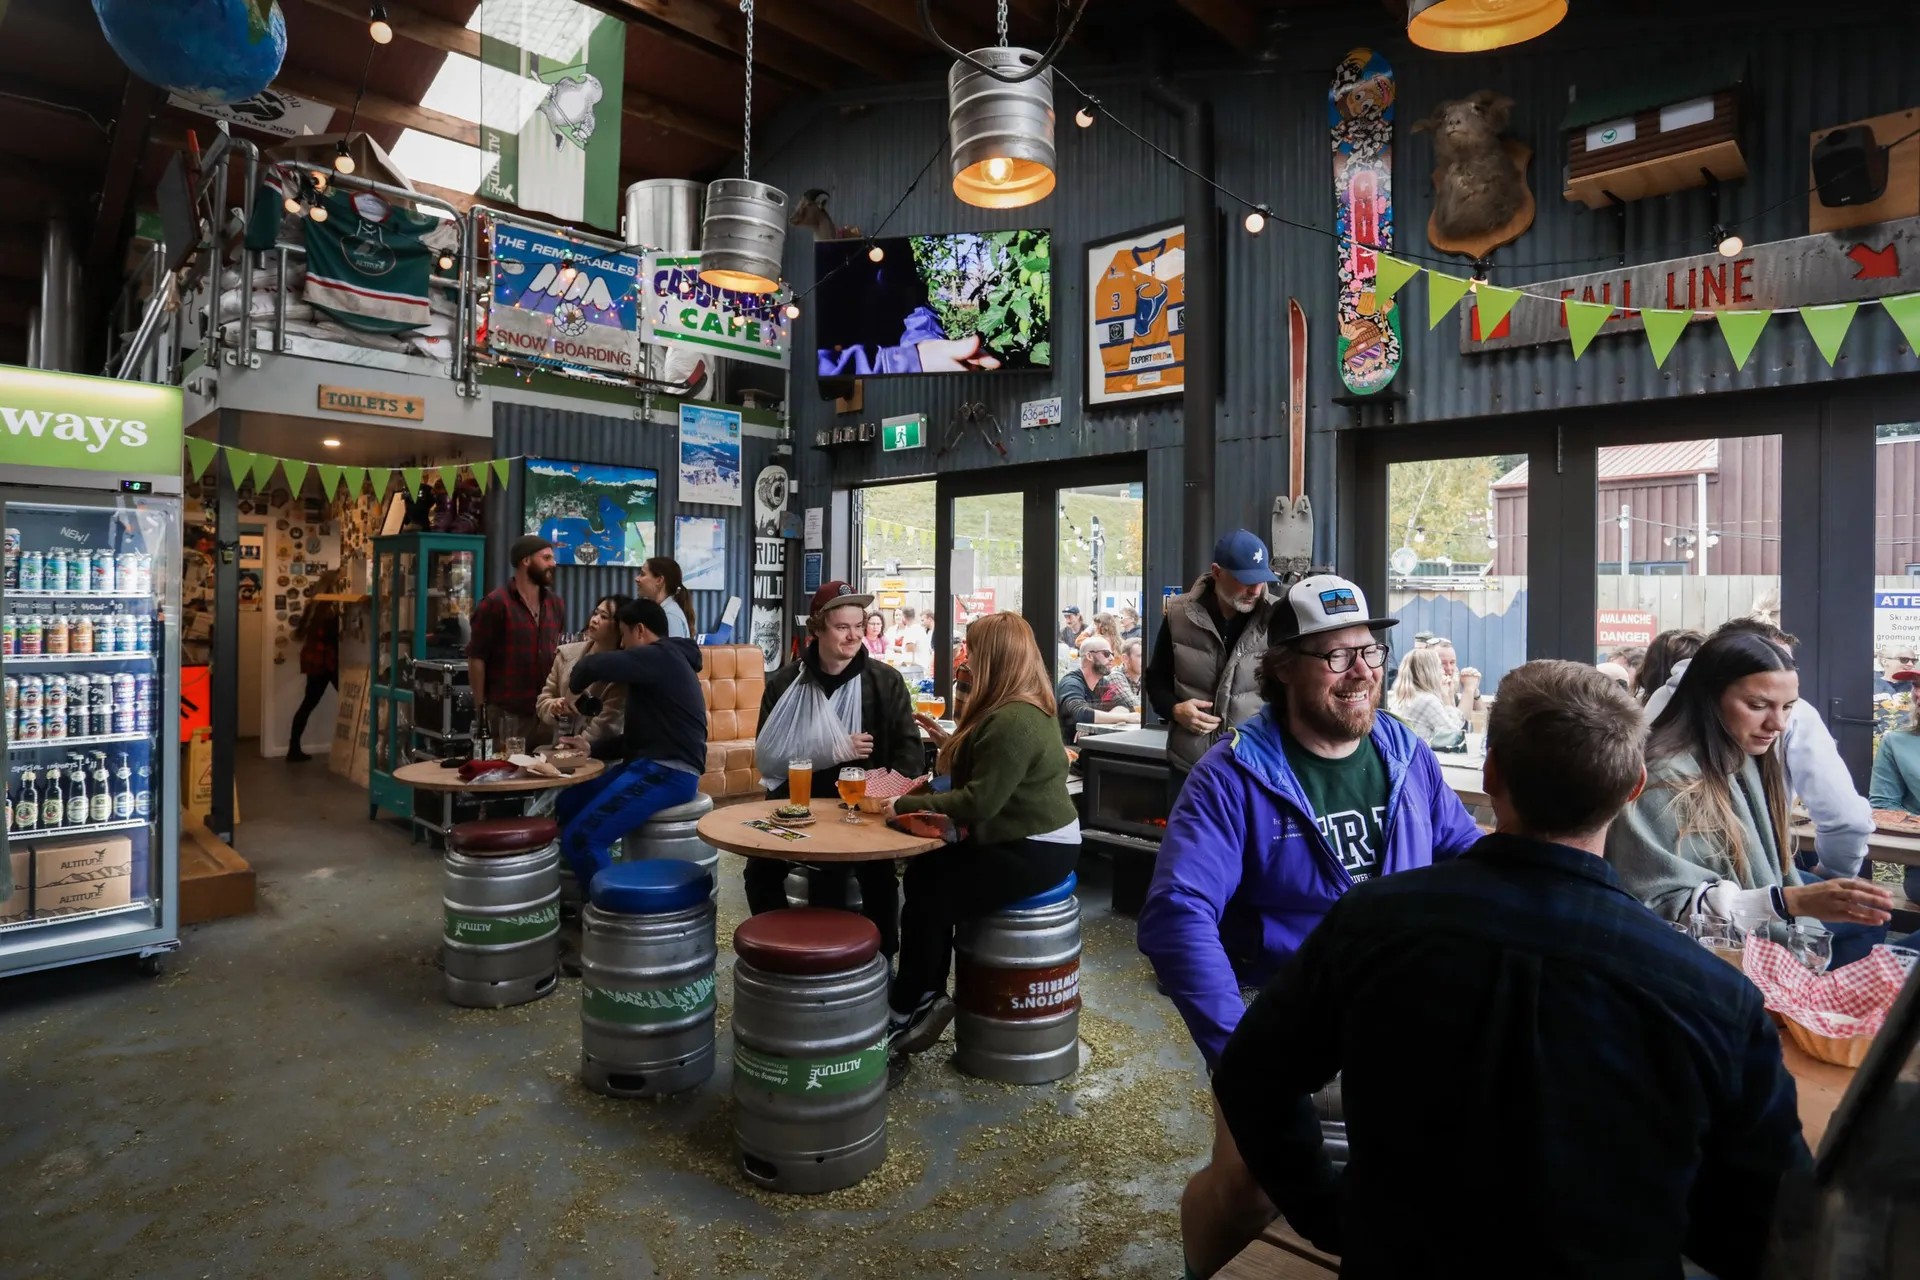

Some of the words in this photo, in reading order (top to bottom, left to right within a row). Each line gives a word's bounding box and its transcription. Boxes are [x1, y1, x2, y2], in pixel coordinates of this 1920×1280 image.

[270, 124, 296, 135] 2020
[497, 234, 527, 249] THE
[531, 243, 636, 277] REMARKABLES
[1666, 258, 1754, 310] LINE
[1111, 293, 1120, 311] 3
[679, 308, 761, 342] CAFE
[496, 329, 547, 350] SNOW
[554, 340, 632, 366] BOARDING
[326, 392, 399, 412] TOILETS
[1022, 408, 1038, 421] 636
[60, 526, 90, 544] NEW!
[756, 542, 785, 564] RIDE
[754, 575, 784, 599] WILD
[1880, 595, 1920, 606] ATTE
[1600, 613, 1652, 625] AVALANCHE
[1600, 631, 1650, 643] DANGER
